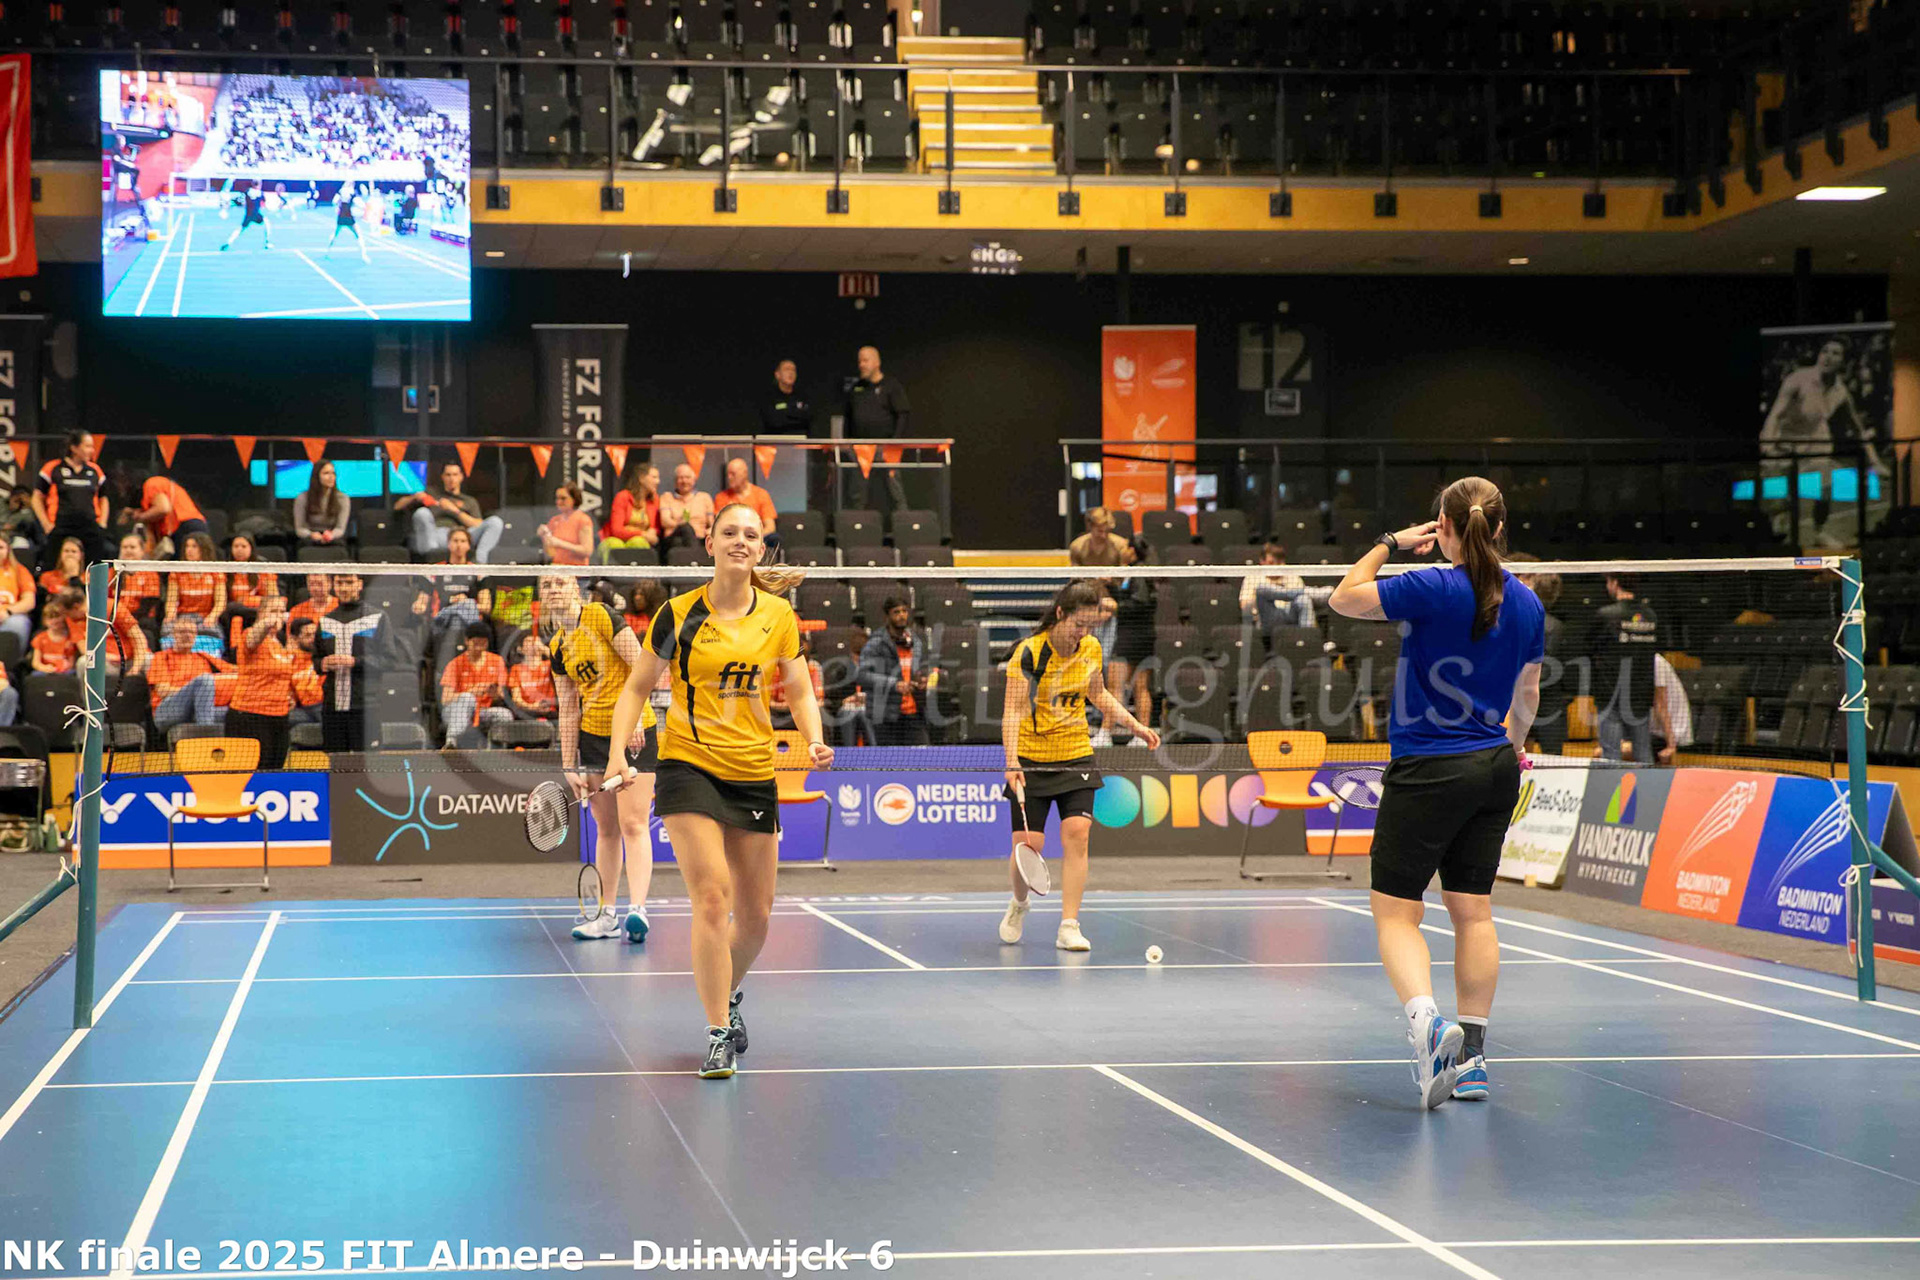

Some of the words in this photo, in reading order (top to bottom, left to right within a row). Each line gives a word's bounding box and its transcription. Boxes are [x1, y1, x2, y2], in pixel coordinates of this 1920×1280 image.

[1247, 321, 1313, 390] 12
[576, 358, 601, 396] FZ
[577, 405, 603, 512] FORZA
[916, 804, 997, 824] LOTERIJ
[1576, 822, 1656, 868] VANDEKOLK
[1577, 862, 1638, 886] HYPOTHEKEN
[1675, 870, 1731, 897] BADMINTON
[1675, 893, 1722, 914] NEDERLAND
[1777, 885, 1845, 916] BADMINTON
[1778, 909, 1831, 934] NEDERLAND
